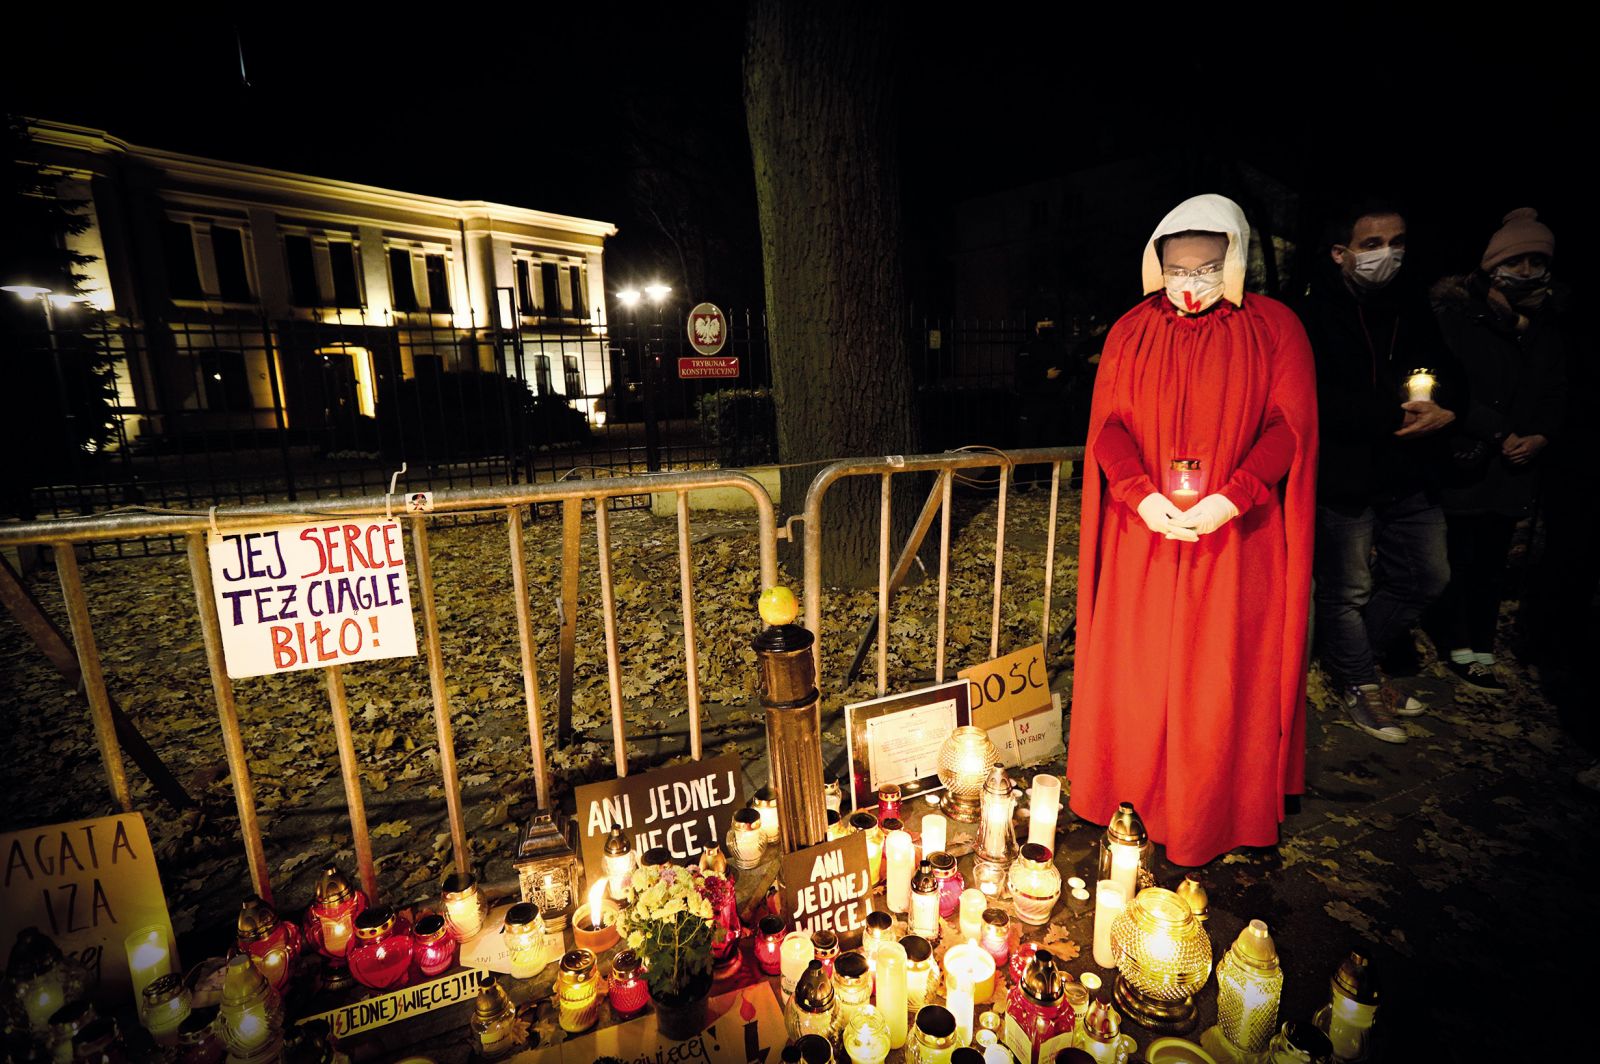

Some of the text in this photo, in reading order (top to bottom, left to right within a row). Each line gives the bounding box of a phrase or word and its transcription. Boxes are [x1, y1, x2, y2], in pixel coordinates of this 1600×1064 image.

[681, 368, 737, 376] KONSTYTUCYJNY
[222, 524, 403, 582] JEJ SERCE
[1005, 732, 1046, 749] JENY FAIRY
[587, 770, 736, 837] ANI JEDNEJ
[5, 820, 137, 887] AGATA
[810, 848, 845, 882] ANI
[43, 878, 117, 935] IZA
[793, 869, 869, 919] JEDNEJ
[340, 996, 398, 1035] JEDNEJ
